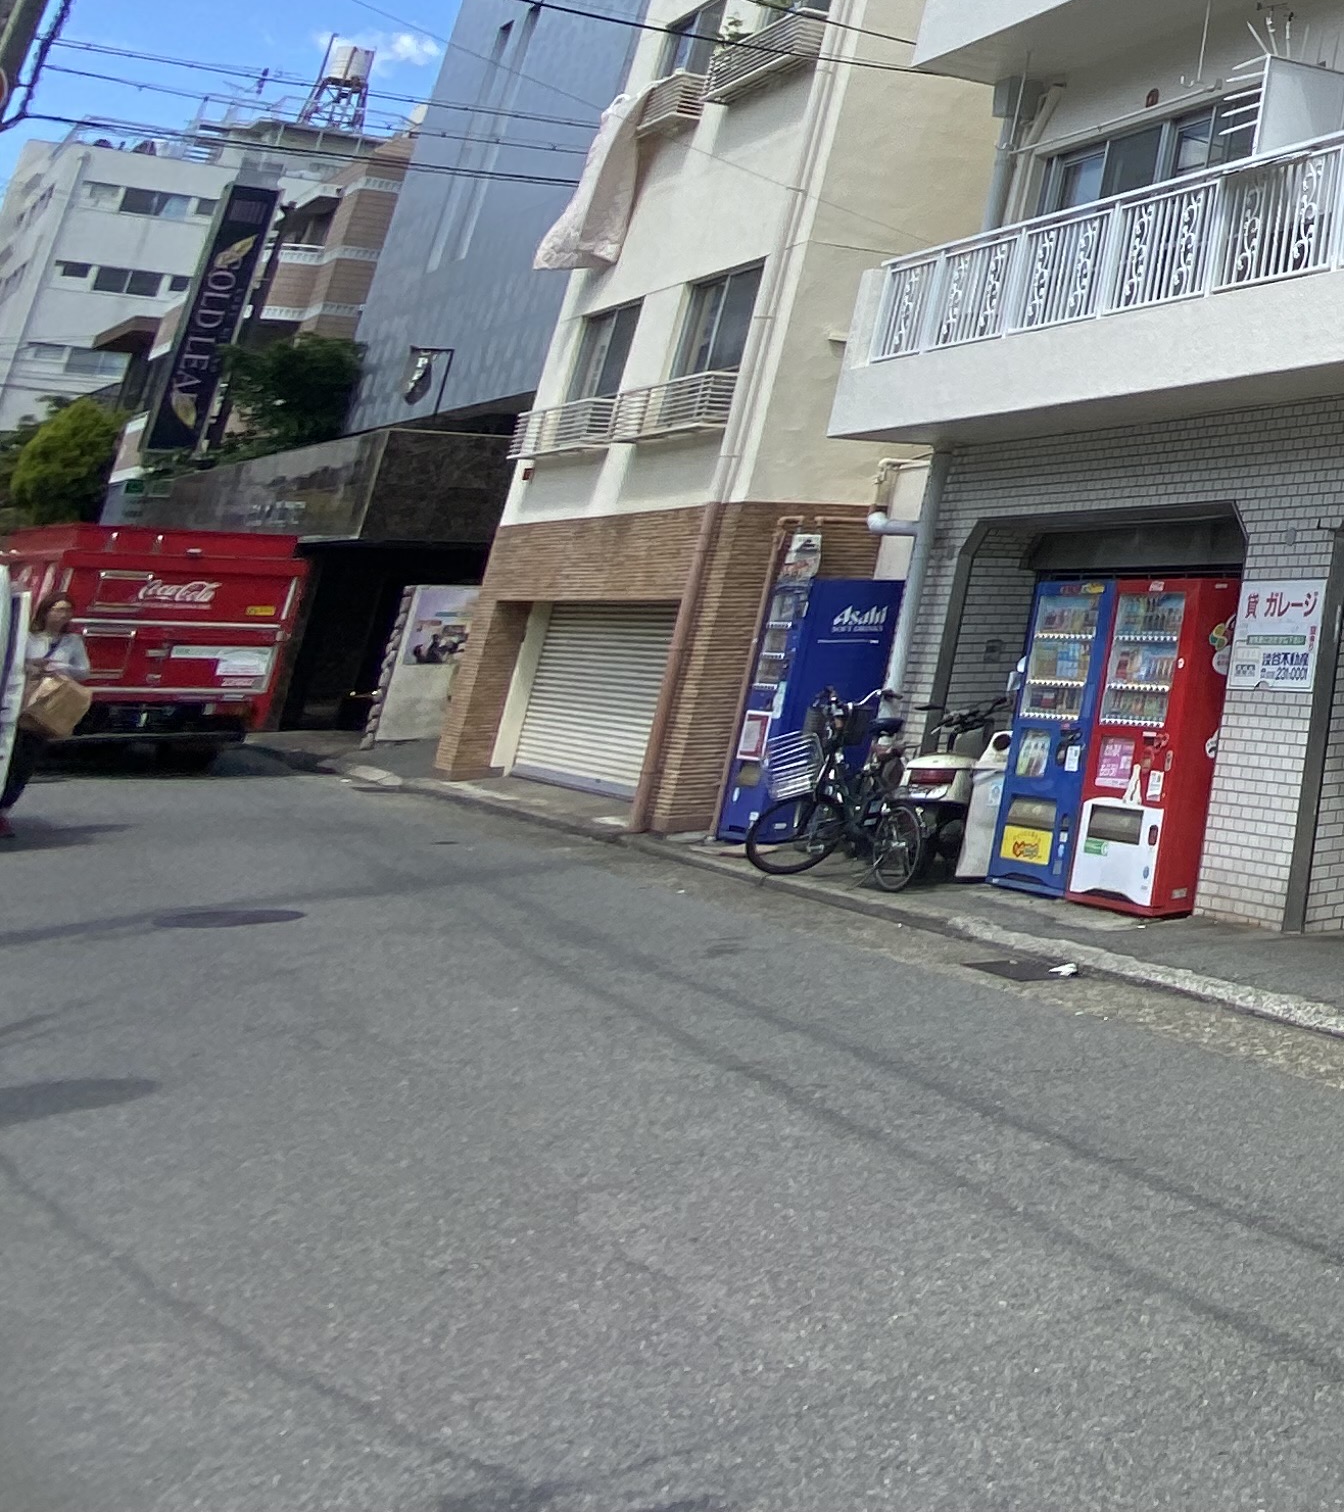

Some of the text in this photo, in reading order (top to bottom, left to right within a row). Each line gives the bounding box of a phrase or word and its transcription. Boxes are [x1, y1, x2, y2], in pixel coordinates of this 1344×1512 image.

[833, 605, 889, 625] Asahi
[1245, 591, 1319, 619] 貸 ガレージ
